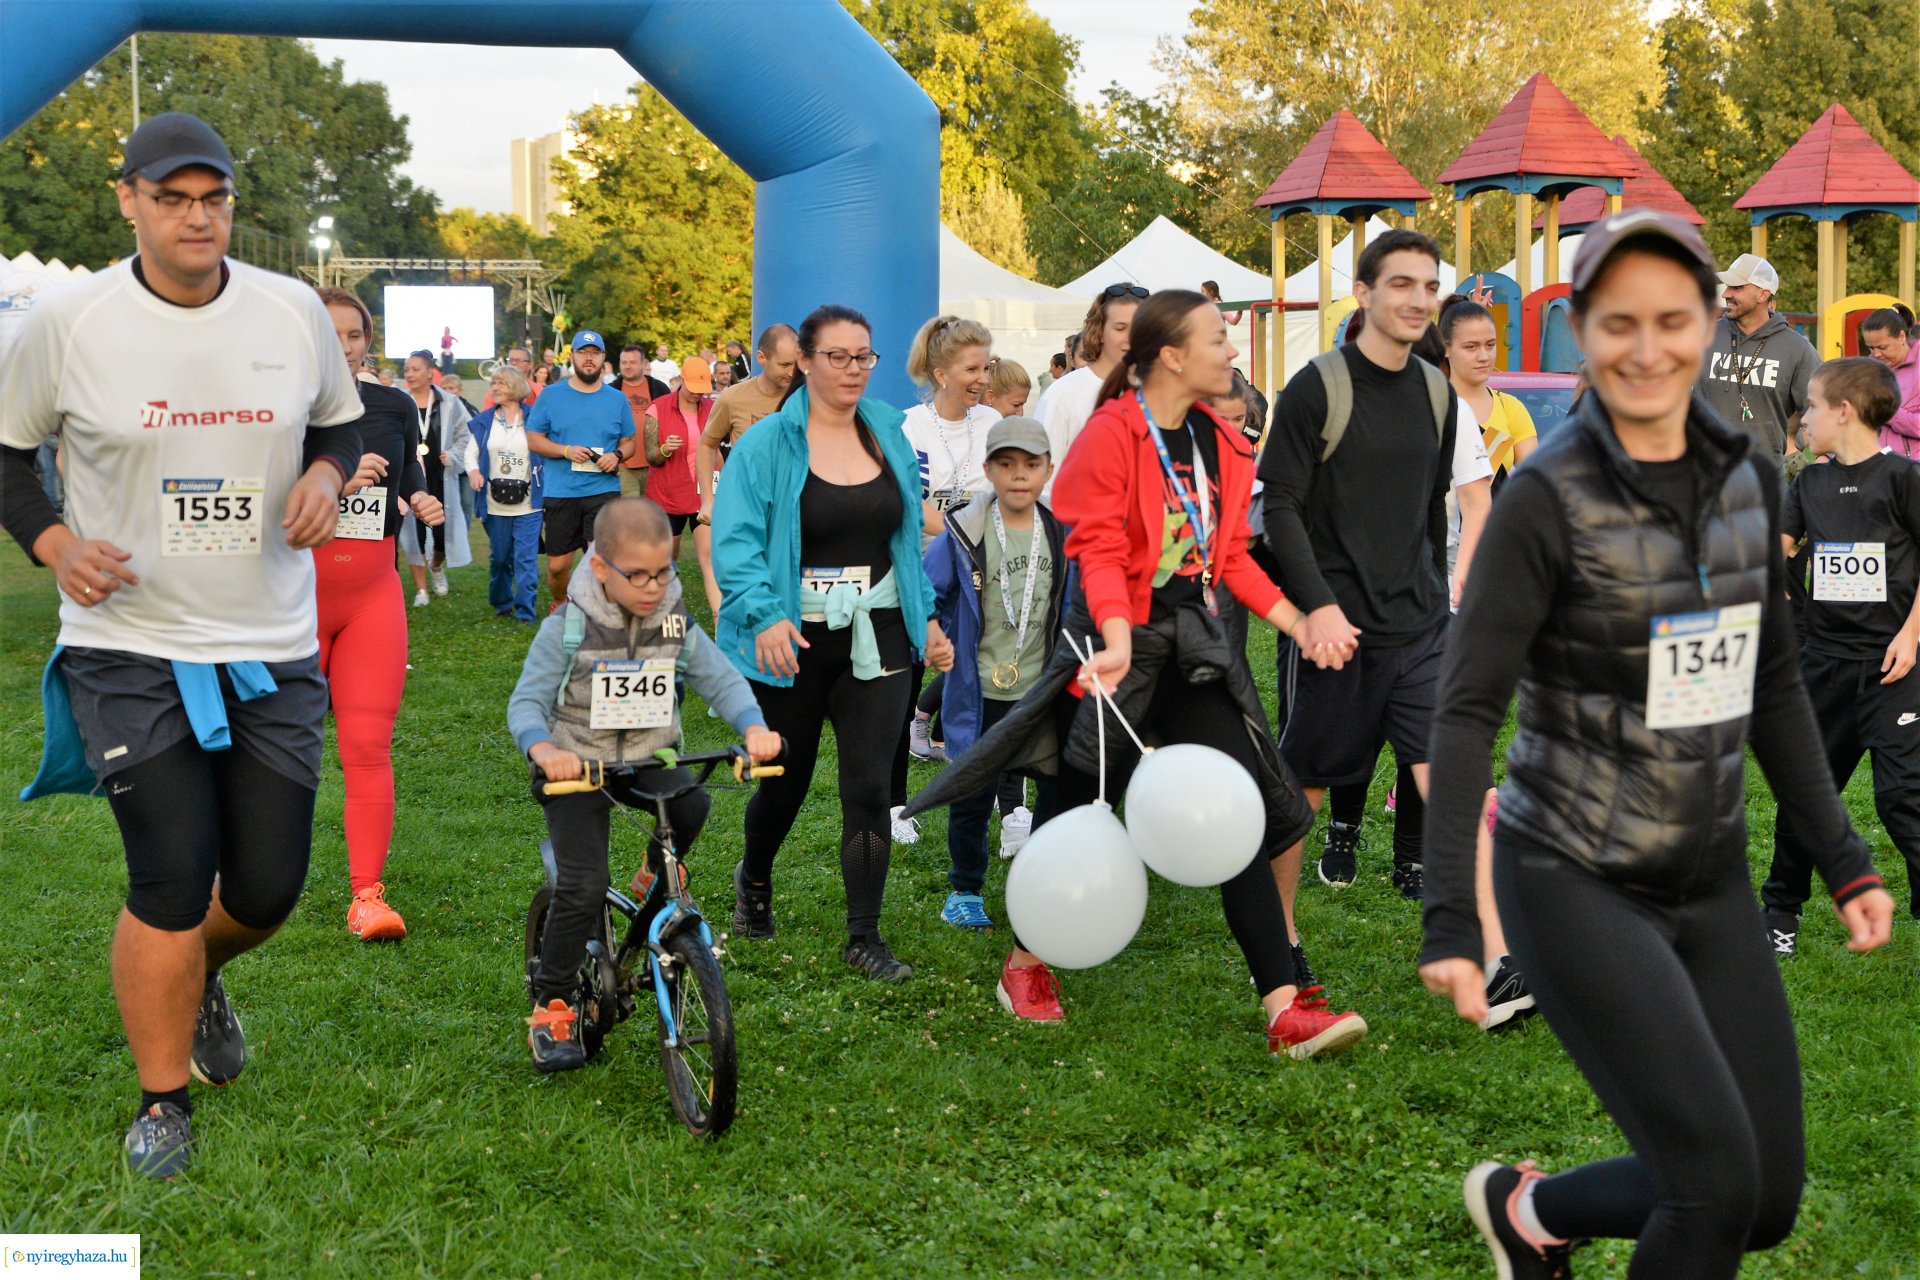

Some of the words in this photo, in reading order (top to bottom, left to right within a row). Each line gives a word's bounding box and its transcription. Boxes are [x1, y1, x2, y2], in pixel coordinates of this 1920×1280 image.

[1709, 351, 1780, 388] NIKE
[171, 409, 274, 427] marso
[174, 496, 252, 522] 1553
[338, 497, 381, 516] 804
[1819, 556, 1880, 575] 1500
[661, 613, 688, 639] HEY
[1667, 632, 1749, 677] 1347
[601, 675, 667, 698] 1346
